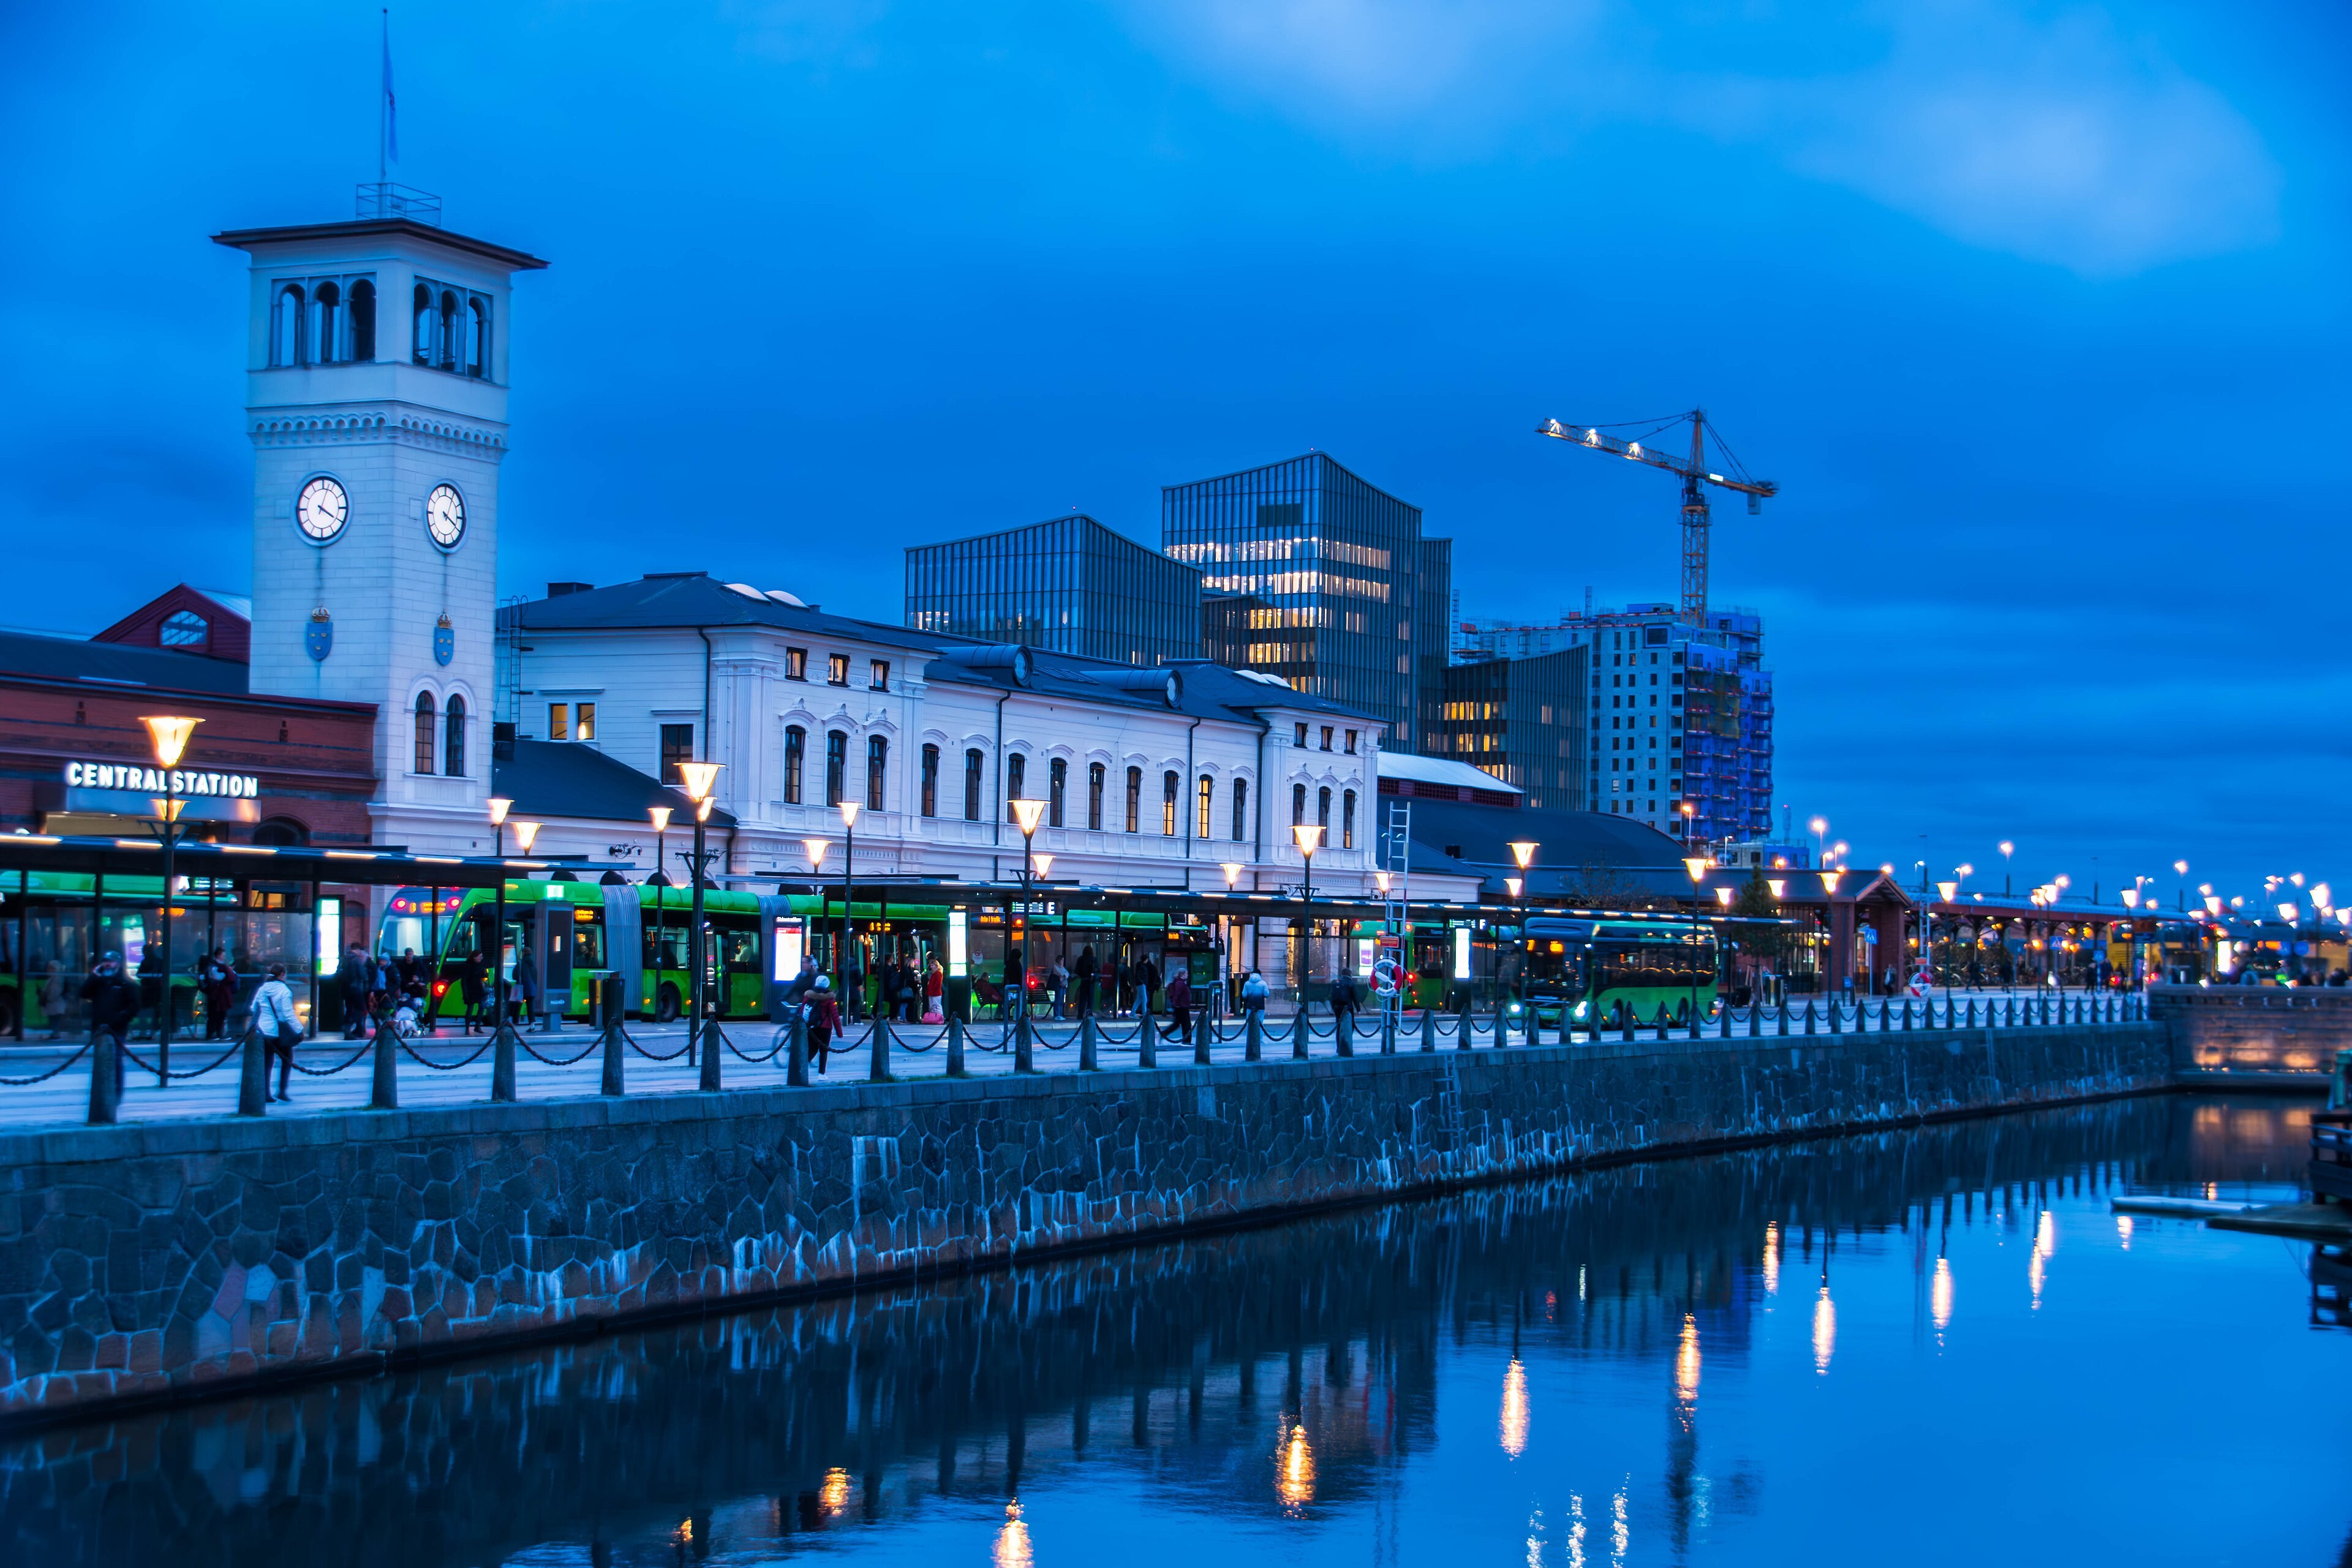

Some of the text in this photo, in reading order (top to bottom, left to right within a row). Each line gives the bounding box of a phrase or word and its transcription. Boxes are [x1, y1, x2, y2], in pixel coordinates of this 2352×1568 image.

[66, 761, 258, 797] CENTRAL STATION
[1047, 902, 1055, 914] E
[1479, 919, 1486, 930] F
